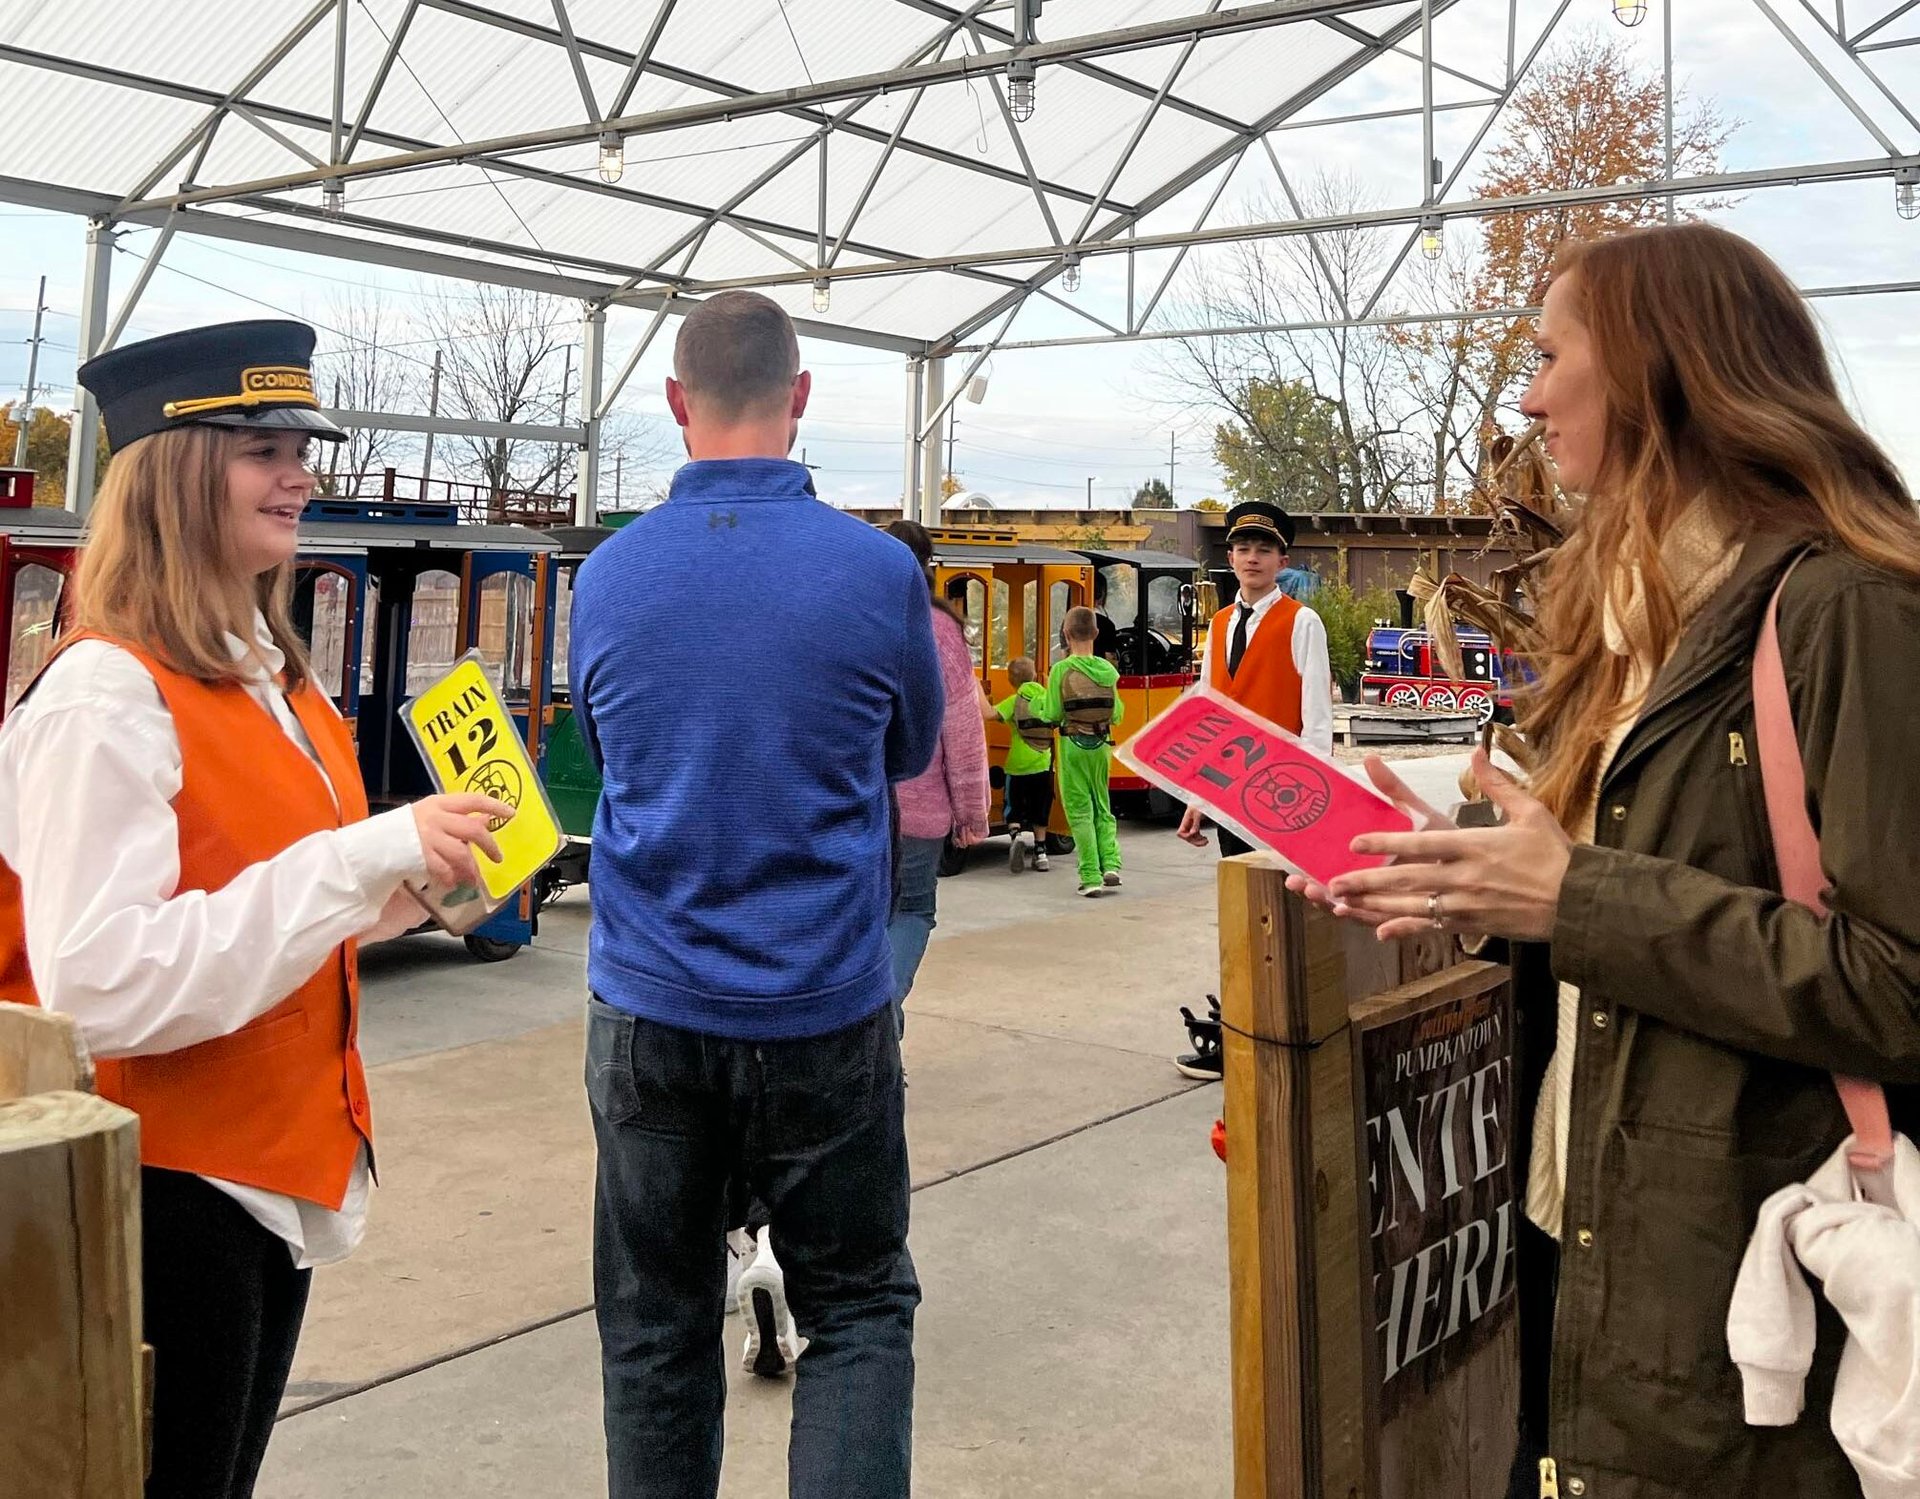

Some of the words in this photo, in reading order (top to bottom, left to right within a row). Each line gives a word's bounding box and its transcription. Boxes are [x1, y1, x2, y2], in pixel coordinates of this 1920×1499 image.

[422, 680, 487, 743] TRAIN
[1153, 709, 1233, 772] TRAIN
[443, 718, 498, 780] 12
[1194, 735, 1267, 790] 12
[1395, 1006, 1502, 1083] PUMPKINTOWN
[1366, 1056, 1511, 1239] NTE
